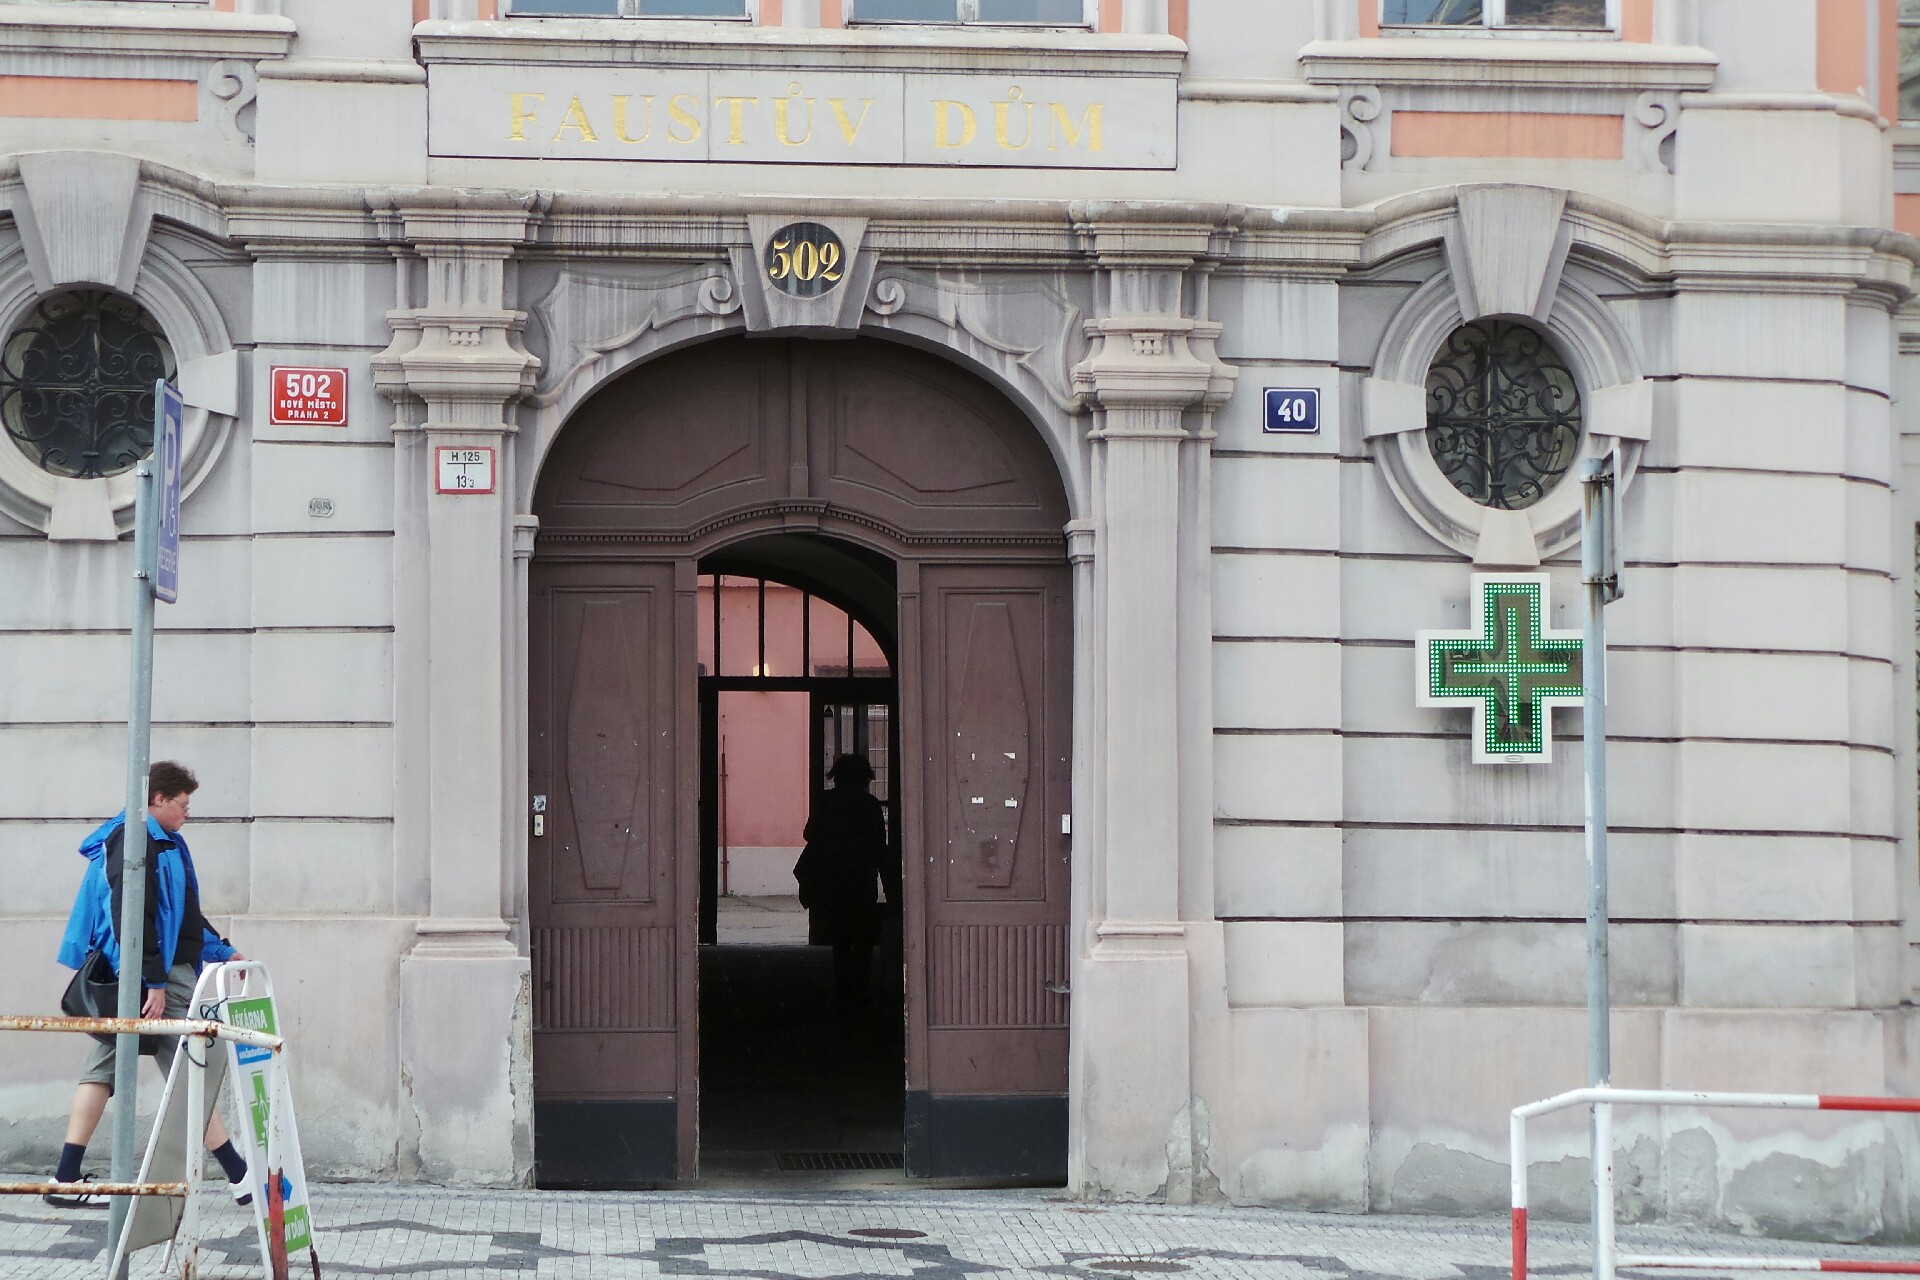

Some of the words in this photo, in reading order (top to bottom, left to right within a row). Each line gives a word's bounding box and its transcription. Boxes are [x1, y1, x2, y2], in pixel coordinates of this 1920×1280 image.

[505, 81, 875, 149] FAUSTŮV
[931, 85, 1106, 151] DŮM
[769, 239, 842, 282] 502
[286, 373, 331, 398] 502
[280, 398, 303, 409] NOVÉ
[307, 398, 337, 410] MĚSTO
[287, 409, 319, 419] PRAHA
[323, 411, 329, 419] 2
[1277, 398, 1306, 422] 40
[451, 451, 459, 462] H
[462, 451, 480, 462] 125
[162, 413, 176, 529] P
